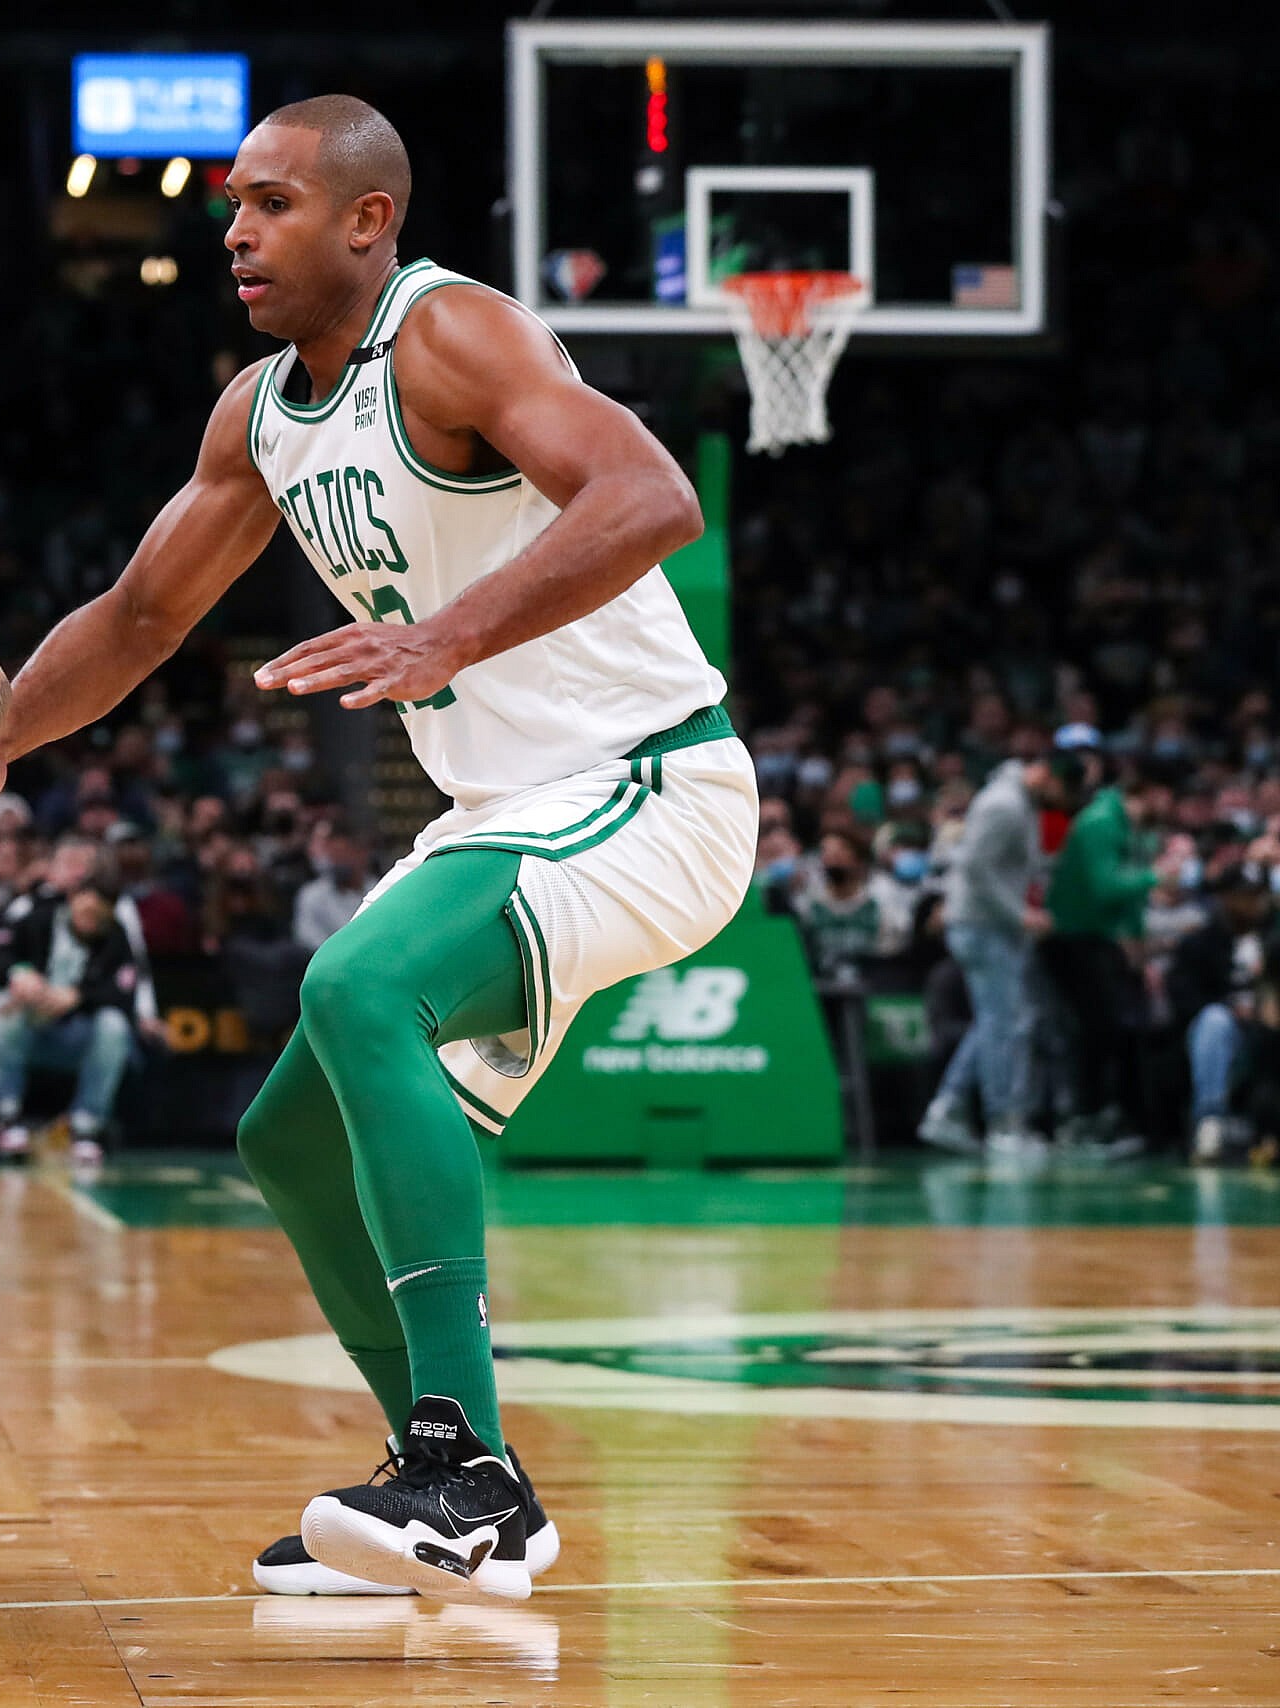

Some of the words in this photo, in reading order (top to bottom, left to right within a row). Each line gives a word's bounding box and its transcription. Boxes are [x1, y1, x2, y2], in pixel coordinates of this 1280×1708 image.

[371, 343, 384, 359] 24
[354, 386, 377, 413] VISTA
[354, 409, 376, 432] PRINT
[277, 466, 410, 579] ELTICS
[583, 1045, 642, 1073] new
[645, 1042, 768, 1074] balance
[410, 1420, 458, 1433] ZOOM
